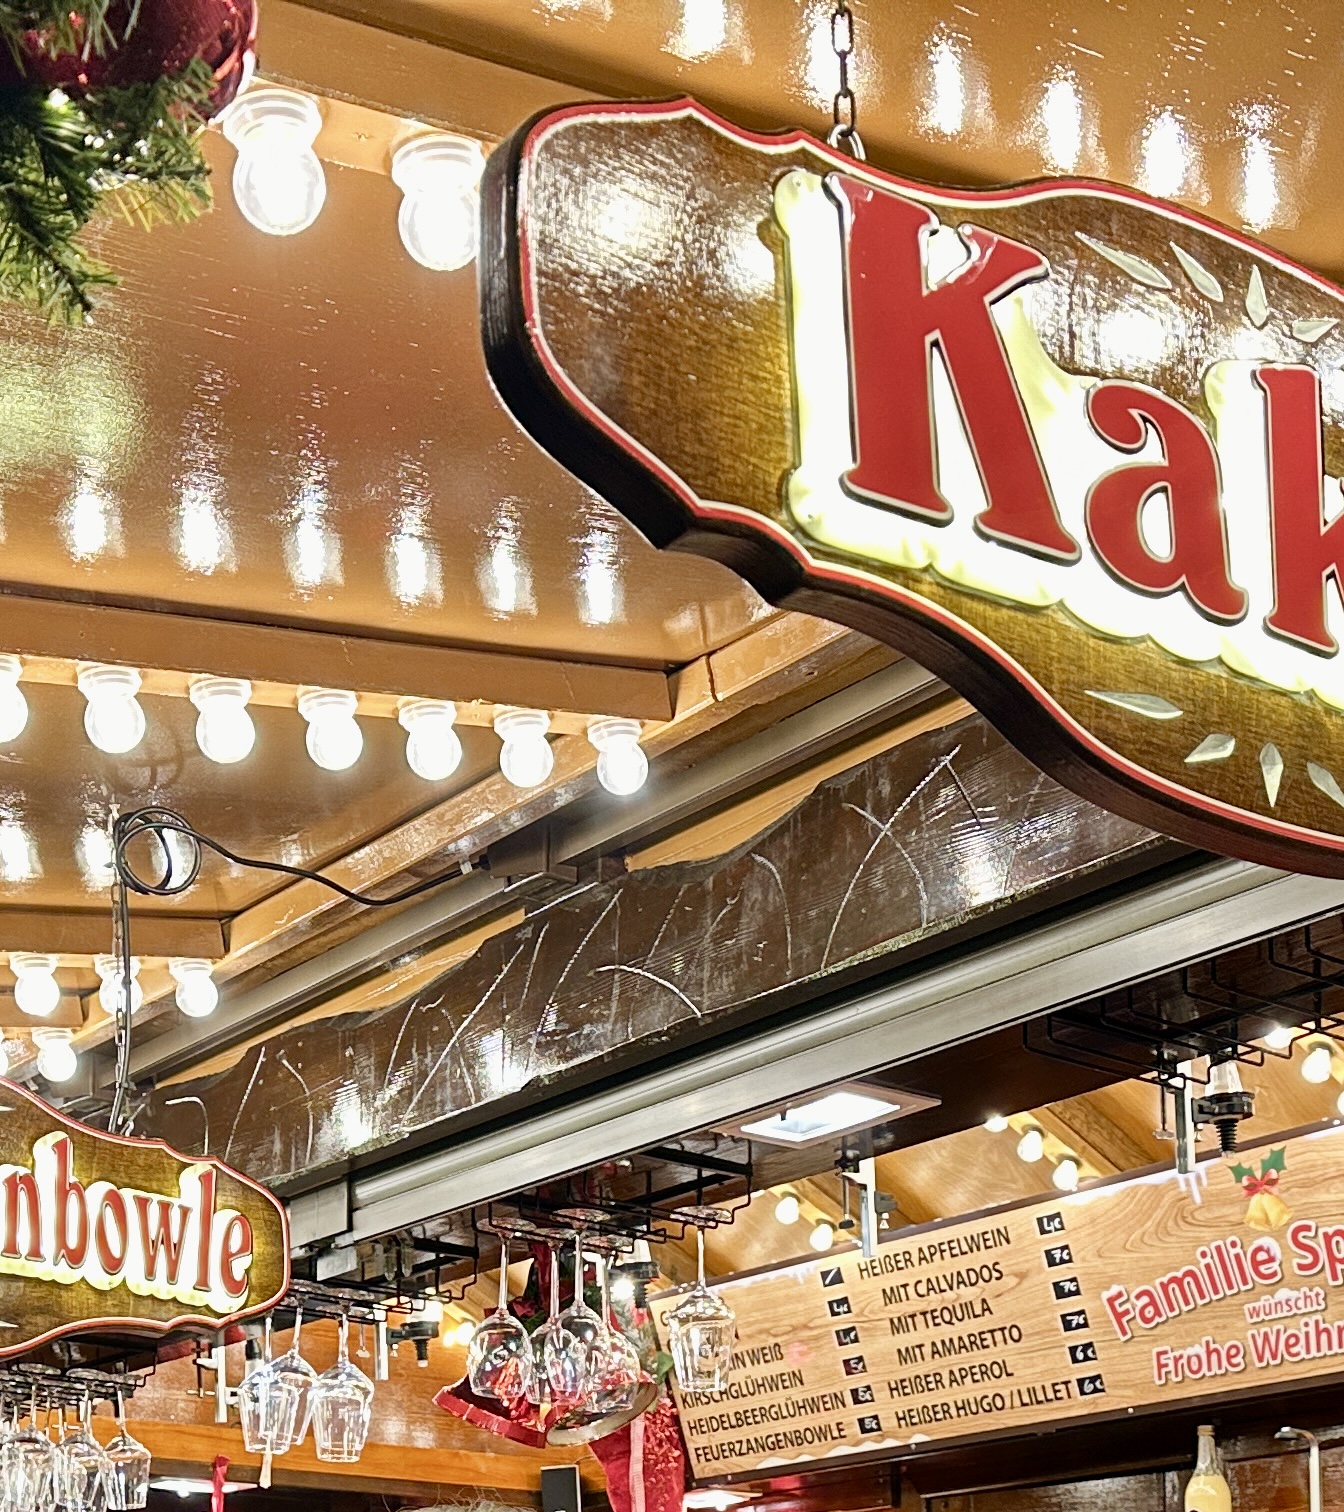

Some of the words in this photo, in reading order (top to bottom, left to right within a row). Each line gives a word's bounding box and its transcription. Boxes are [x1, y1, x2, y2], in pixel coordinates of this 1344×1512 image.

[858, 1247, 914, 1281] HEIßER
[918, 1226, 1012, 1268] APFELWEIN
[882, 1283, 912, 1306] MIT
[914, 1261, 1004, 1299] CALVADOS
[1107, 1234, 1283, 1338] Familie
[1246, 1288, 1325, 1321] wünscht
[889, 1314, 919, 1336] MIT
[921, 1298, 993, 1330] TEQUILA
[897, 1344, 926, 1366] MIT
[927, 1324, 1023, 1360] AMARETTO
[1155, 1335, 1244, 1383] Frohe
[680, 1368, 805, 1410] KIRSCHGLÜHWEIN
[888, 1373, 946, 1399] HEIßER
[948, 1358, 1014, 1390] APEROL
[686, 1390, 847, 1437] HEIDELBEERGLÜHWEIN
[895, 1401, 953, 1429] HEIßER
[955, 1388, 1005, 1418] HUGO
[1018, 1380, 1073, 1408] LILLET
[694, 1420, 847, 1464] FEUERZANGENBOWLE
